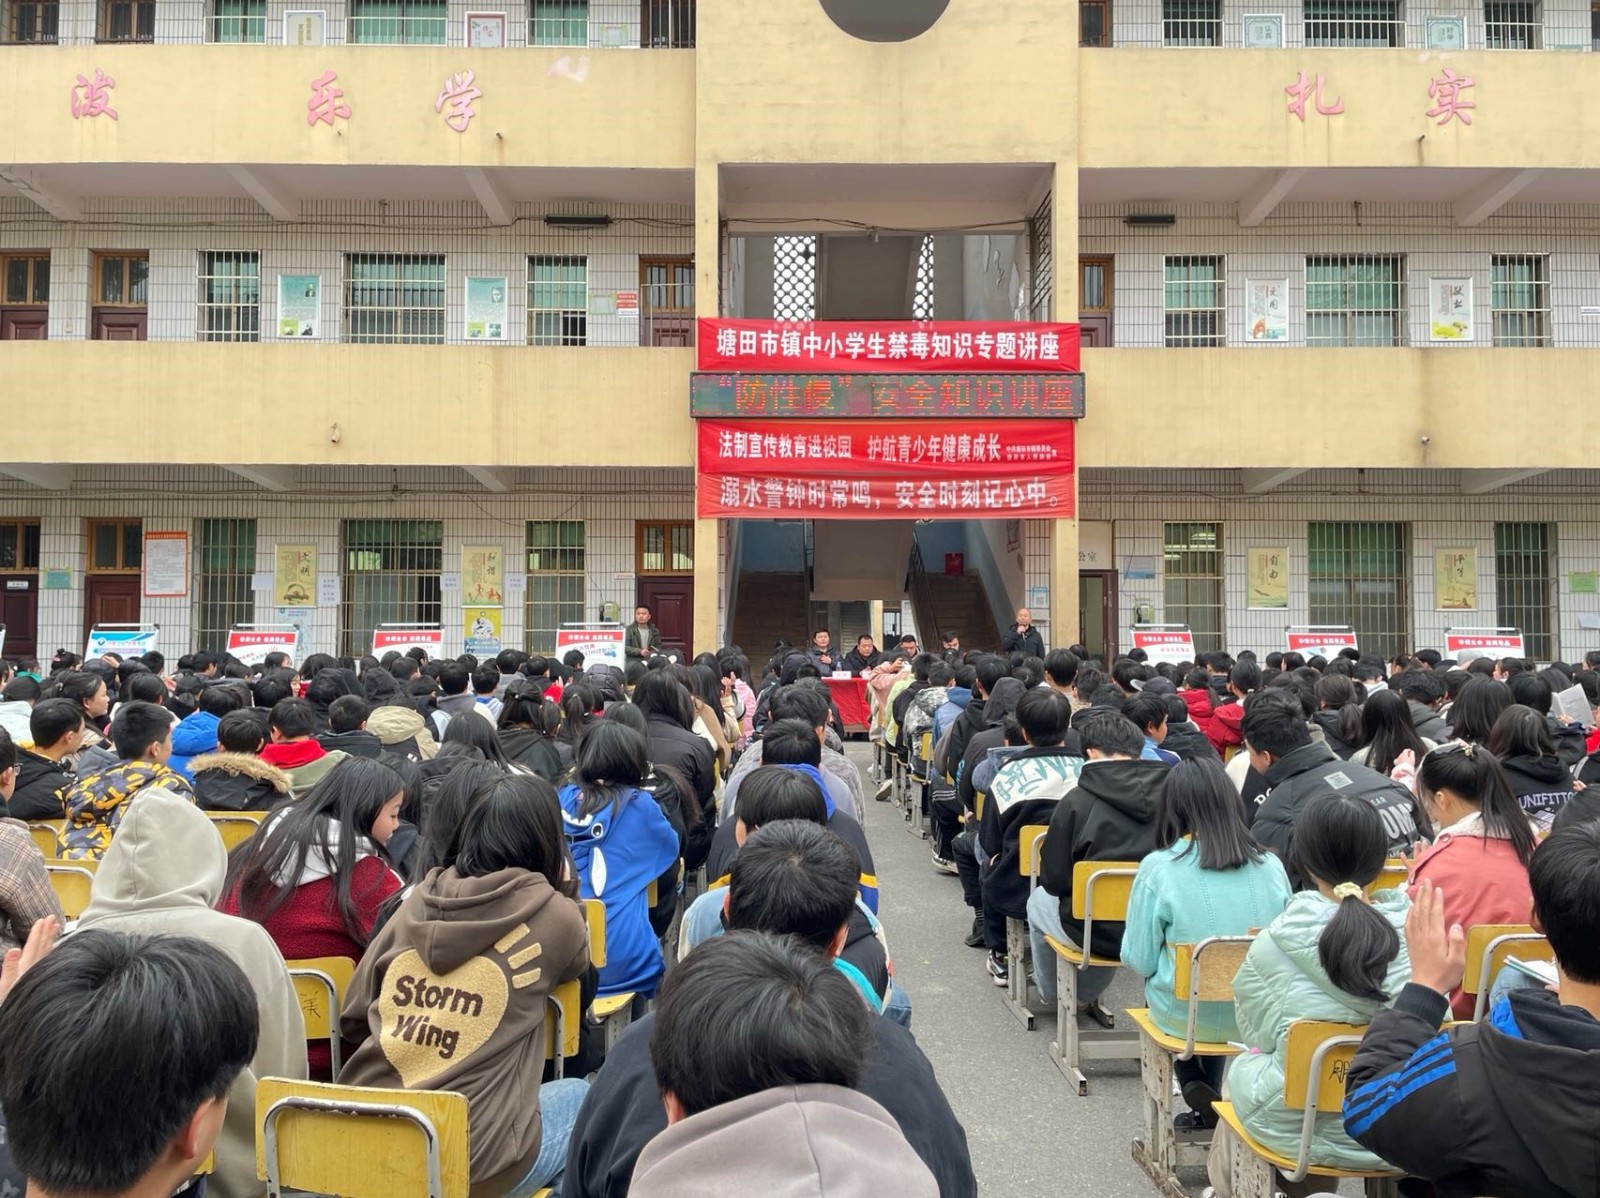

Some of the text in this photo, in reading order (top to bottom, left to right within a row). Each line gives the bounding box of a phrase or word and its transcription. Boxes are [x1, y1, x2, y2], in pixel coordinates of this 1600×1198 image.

[434, 69, 483, 132] 学
[1285, 68, 1477, 126] 扎 实
[716, 328, 1060, 360] 塘田市镇中小学生禁毒知识专题讲座
[719, 430, 1001, 463] 法制宣传教育进校园 护航青少年健康成长
[300, 551, 311, 577] 文明
[392, 974, 484, 1018] Storm
[390, 1014, 461, 1060] Wing
